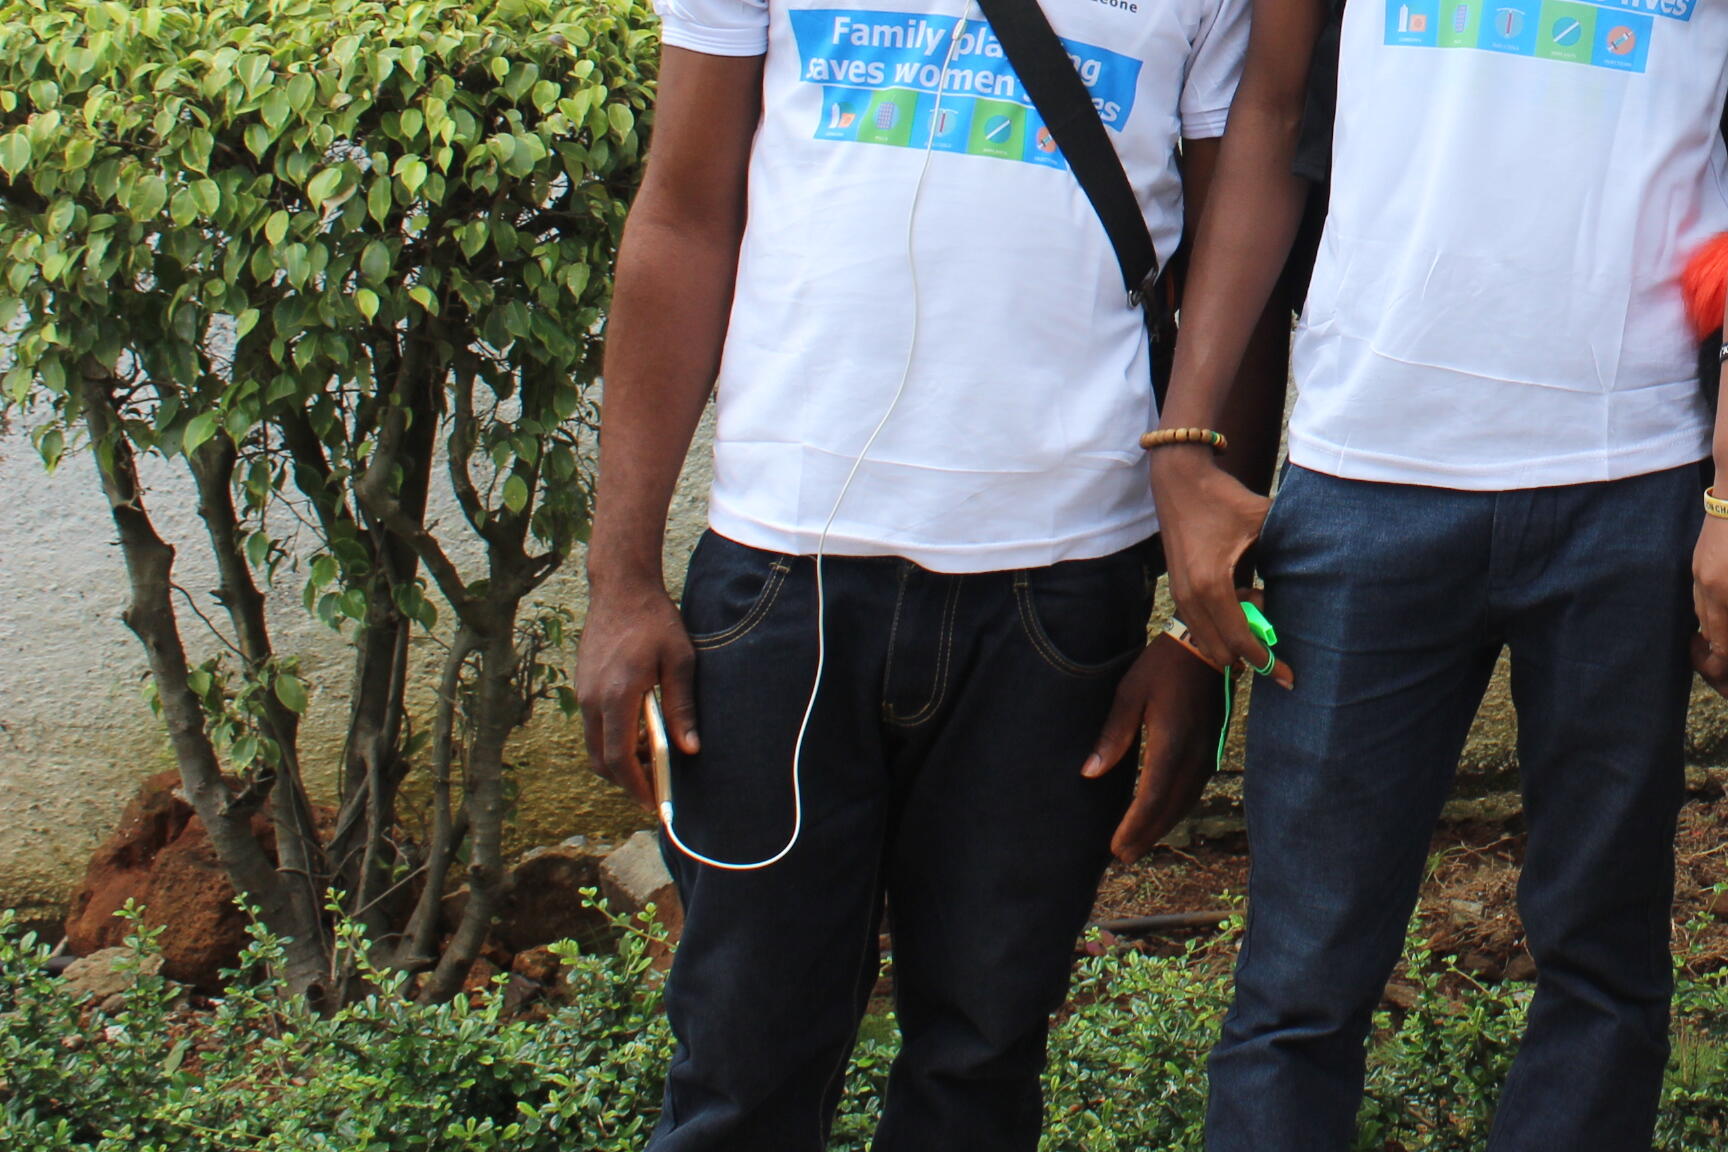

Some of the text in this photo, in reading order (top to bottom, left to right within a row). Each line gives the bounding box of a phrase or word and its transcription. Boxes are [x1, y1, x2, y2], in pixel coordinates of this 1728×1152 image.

[806, 57, 885, 84] saves
[832, 16, 1102, 86] Family plang
